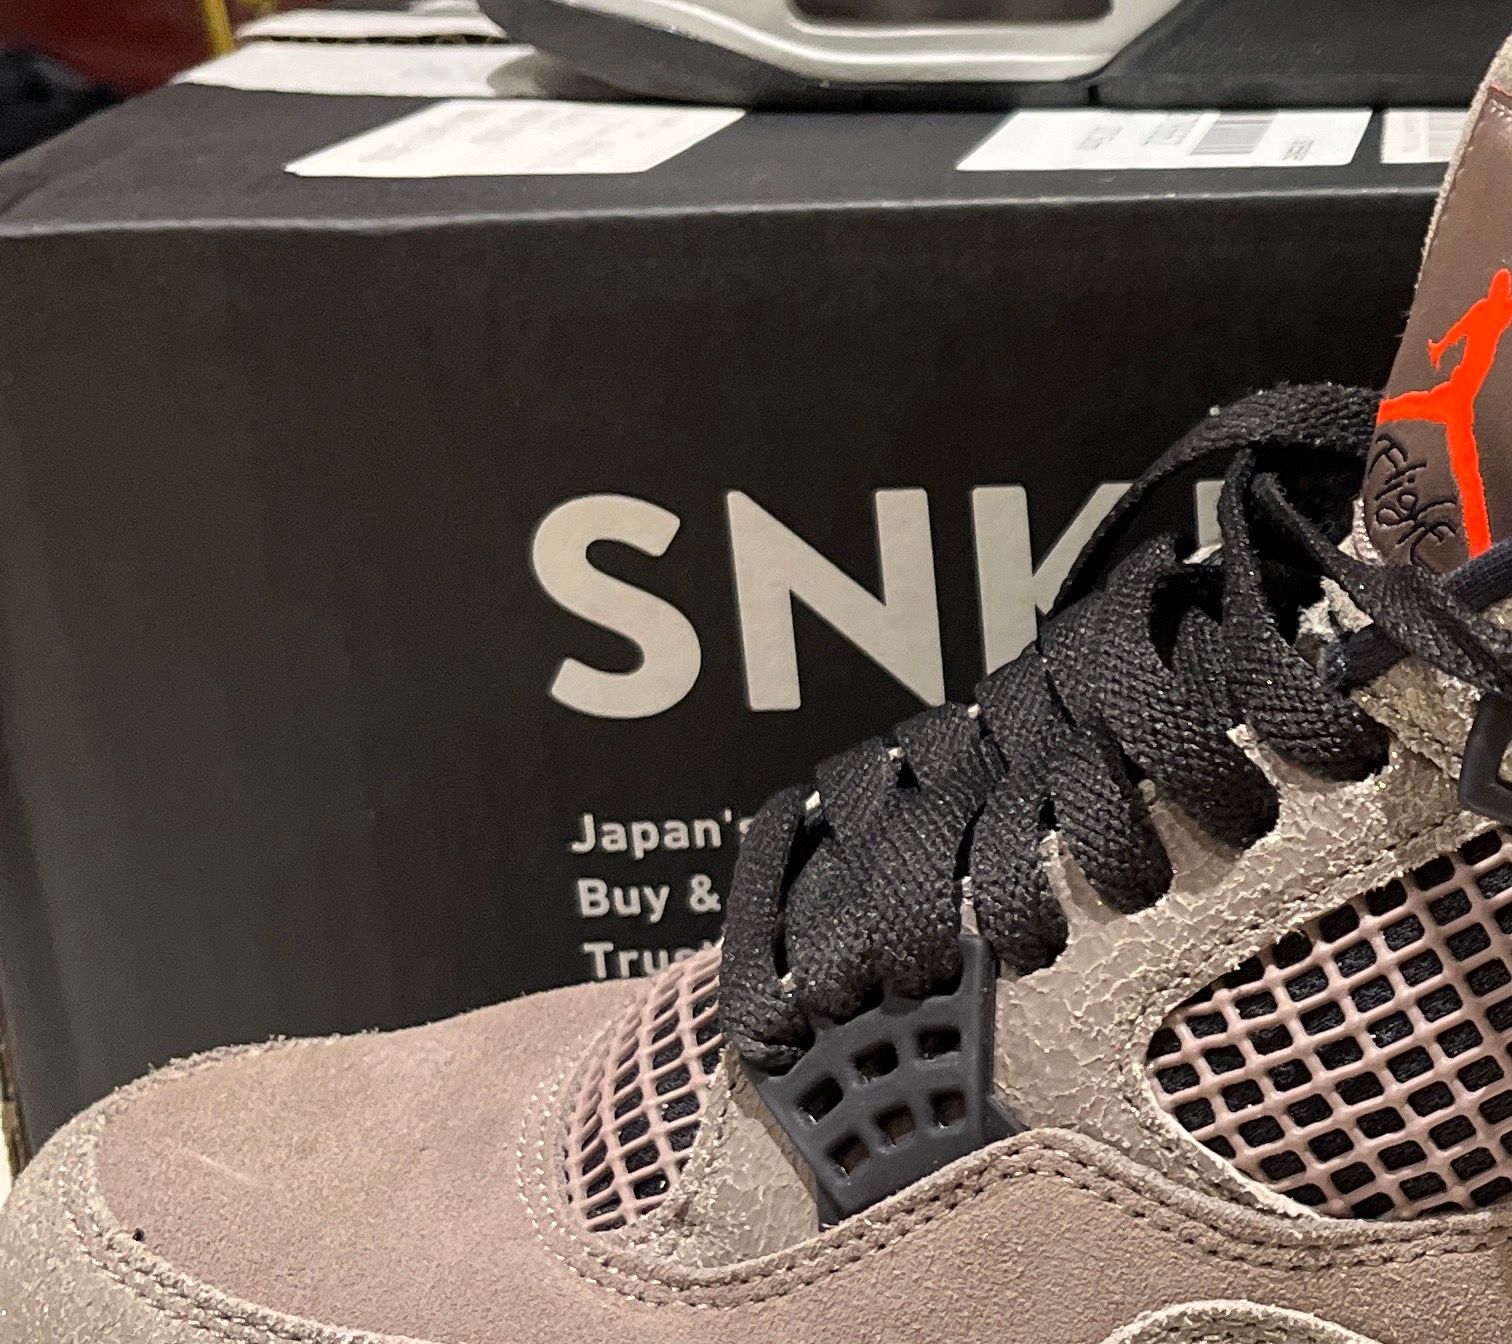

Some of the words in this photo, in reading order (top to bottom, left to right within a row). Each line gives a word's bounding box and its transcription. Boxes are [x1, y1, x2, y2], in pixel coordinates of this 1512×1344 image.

[531, 478, 1226, 718] SNK
[576, 876, 671, 924] Buy
[688, 872, 723, 915] &
